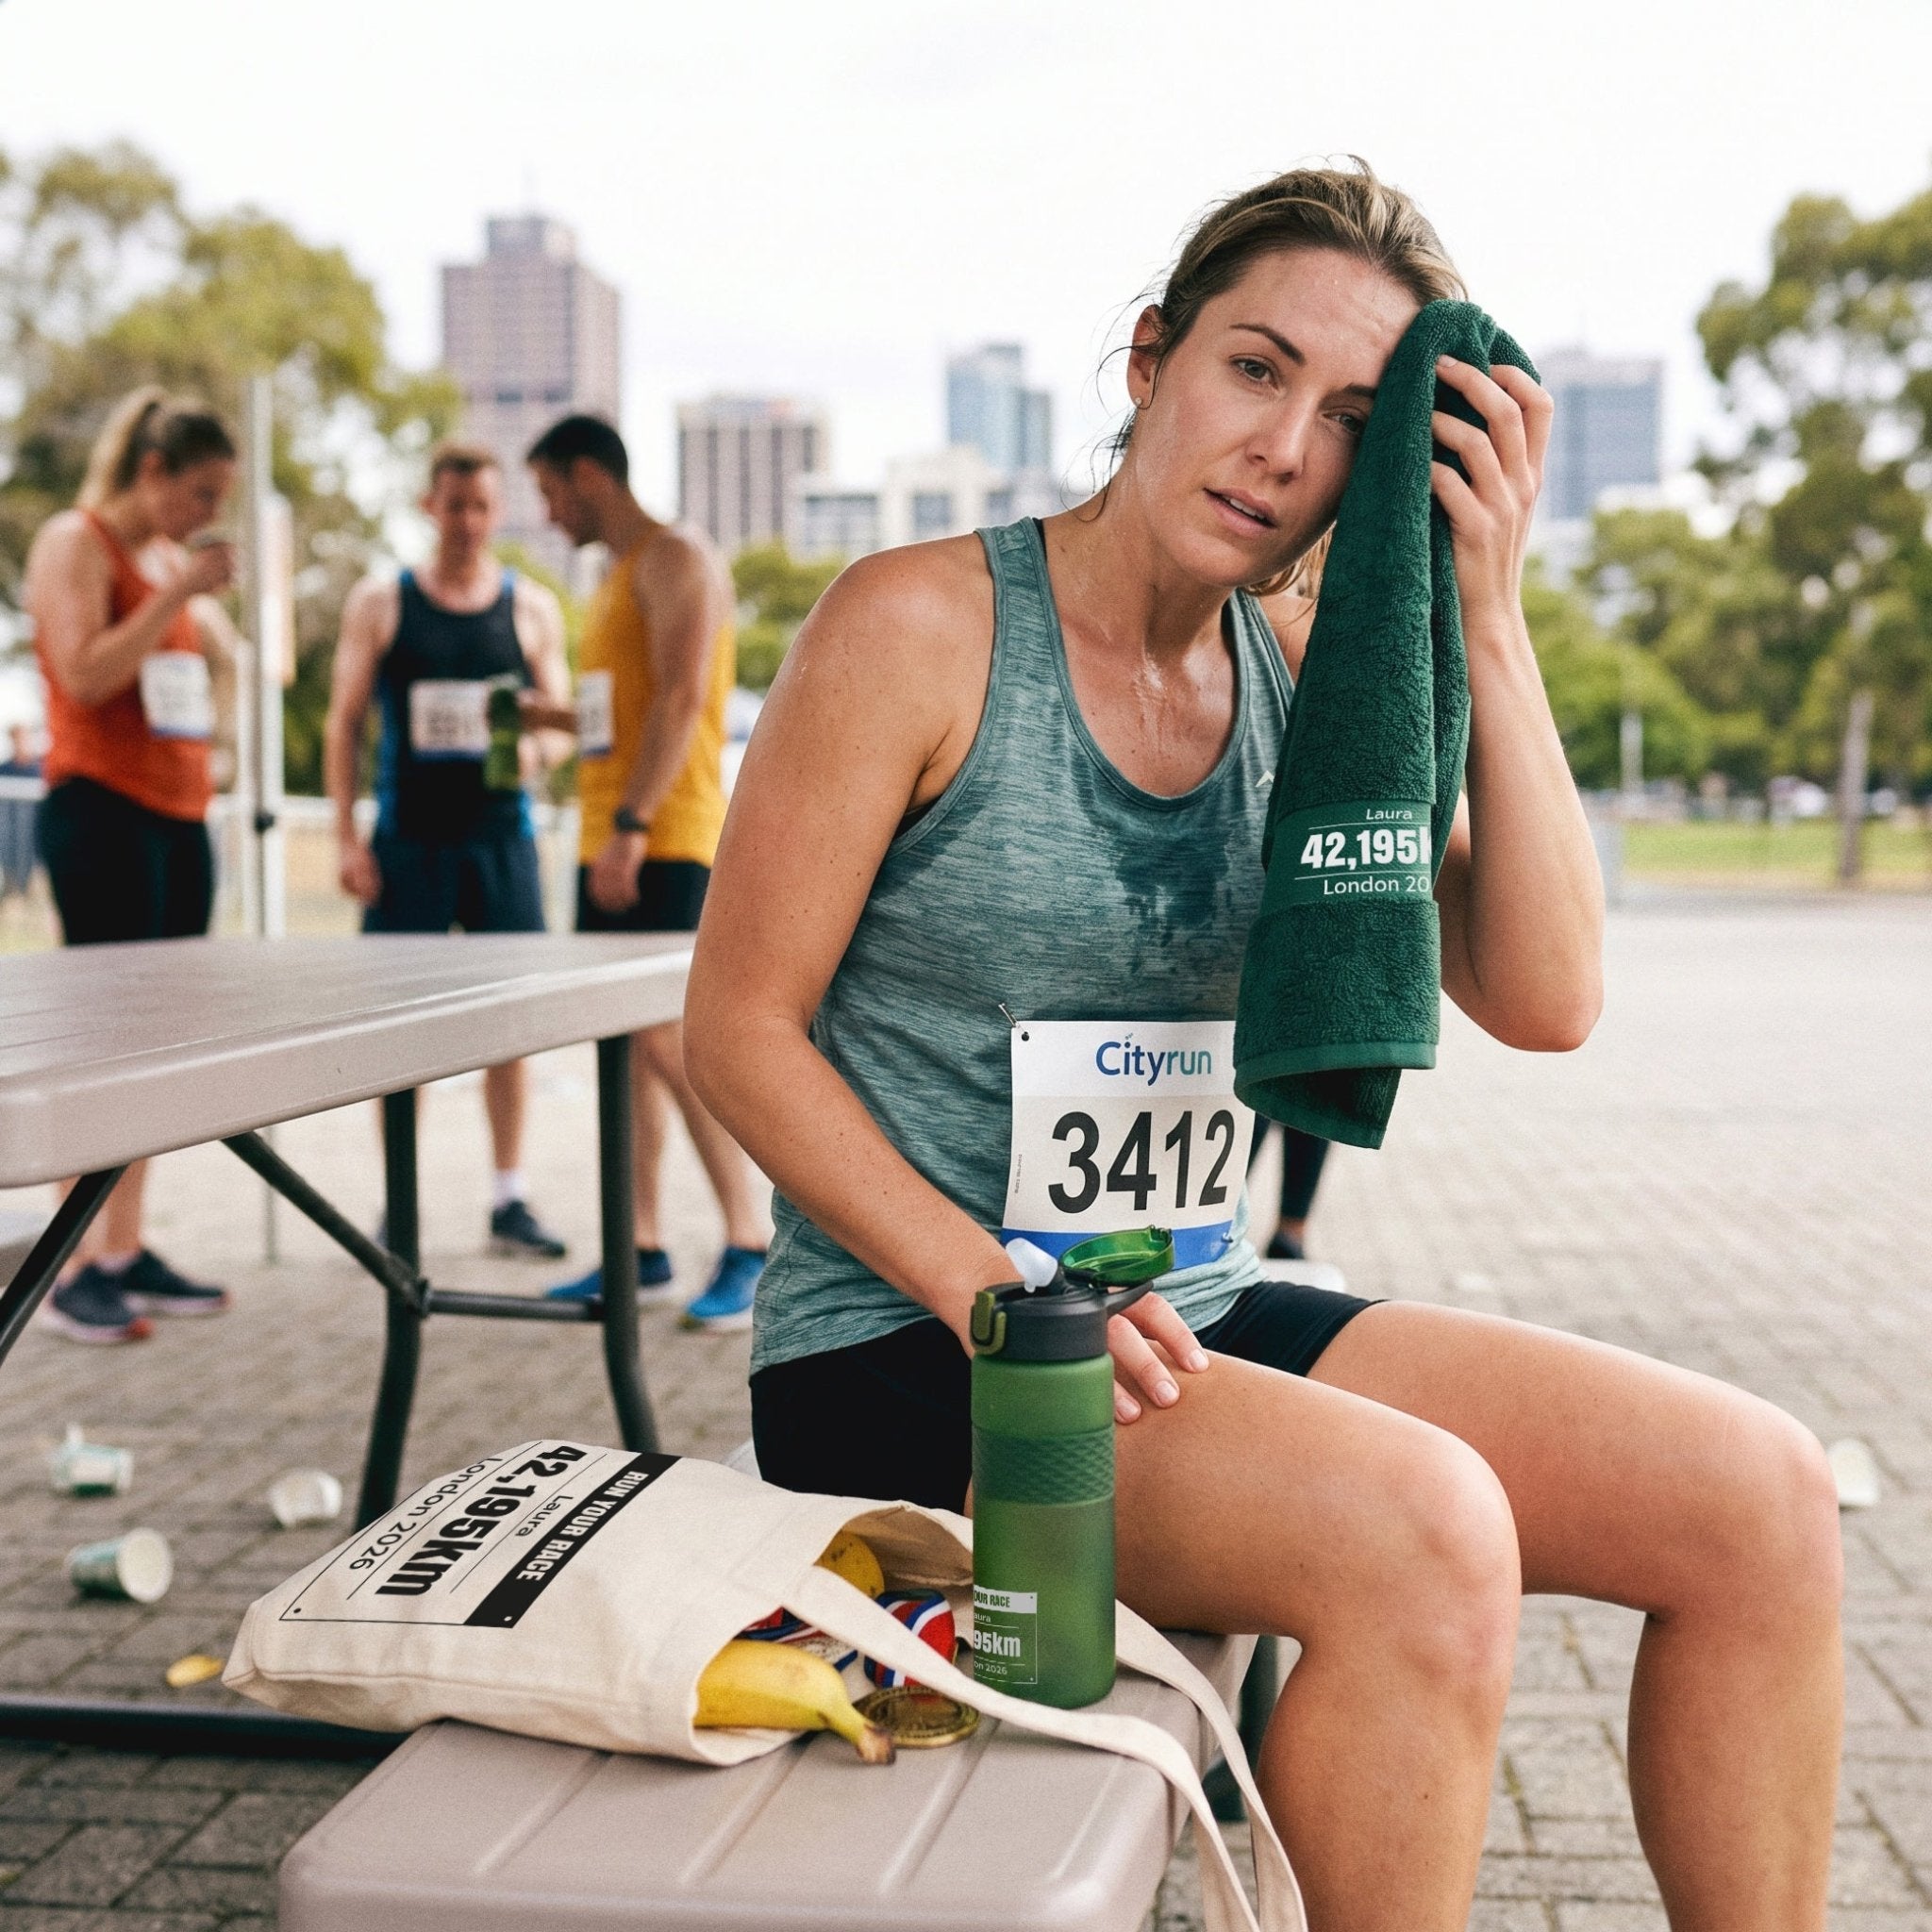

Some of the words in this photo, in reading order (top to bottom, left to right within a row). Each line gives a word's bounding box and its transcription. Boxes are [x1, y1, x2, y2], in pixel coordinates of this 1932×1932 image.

[1365, 808, 1413, 821] Laura
[1324, 875, 1399, 895] London
[1405, 875, 1430, 892] 20
[1095, 1041, 1212, 1086] Cityrun
[1048, 1108, 1236, 1214] 3412
[408, 1457, 504, 1519] London
[604, 1471, 649, 1499] RUN
[375, 1445, 588, 1596] 42,195km
[514, 1495, 574, 1538] Laura
[559, 1500, 618, 1538] YOUR
[349, 1522, 418, 1572] 2026
[516, 1539, 575, 1582] RACE
[990, 1594, 1010, 1608] RACE
[985, 1663, 1008, 1674] 2026
